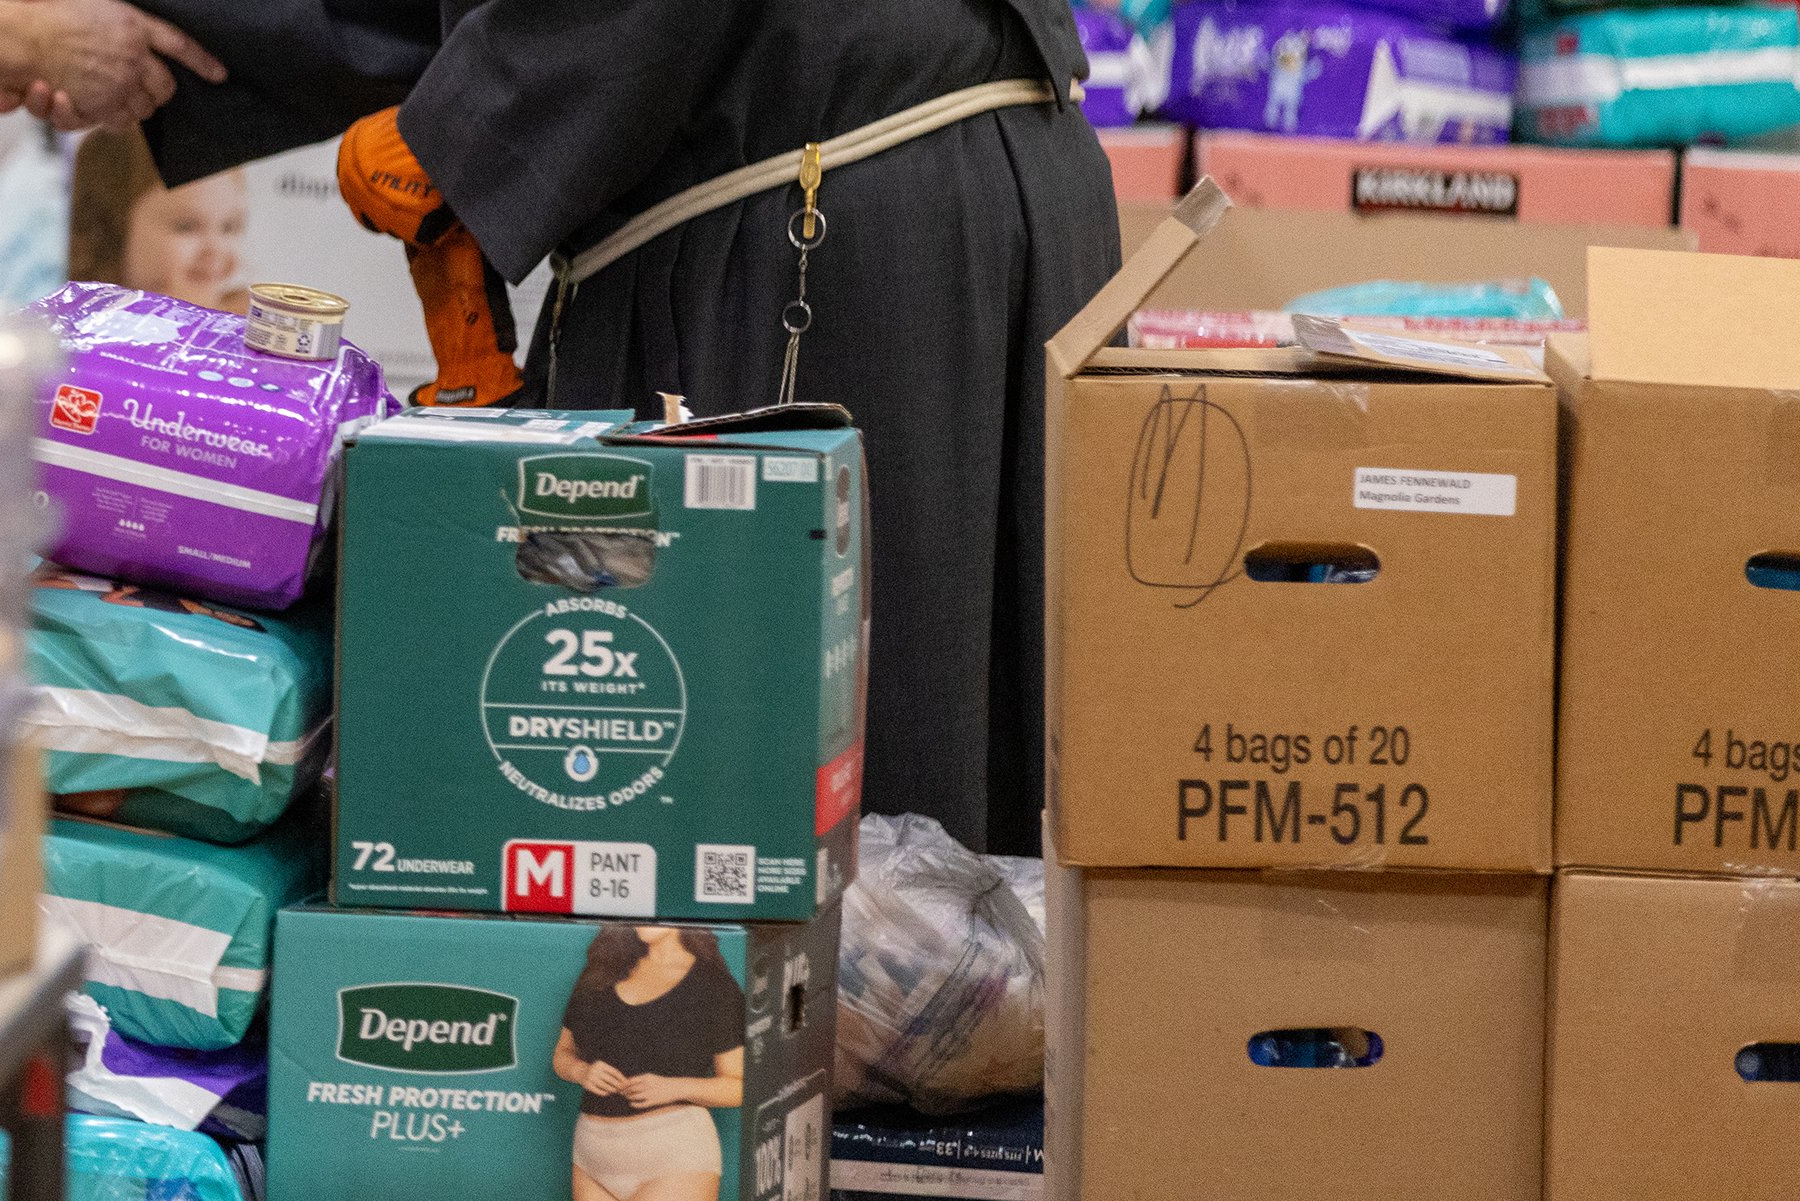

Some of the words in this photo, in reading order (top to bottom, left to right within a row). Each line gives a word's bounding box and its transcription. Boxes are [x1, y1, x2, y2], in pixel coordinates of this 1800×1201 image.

[371, 170, 433, 197] UTILITY
[1357, 169, 1516, 209] KIRKLAND
[123, 399, 270, 457] Underwear
[140, 436, 170, 453] FOR
[175, 441, 237, 469] WOMEN
[1360, 474, 1397, 485] JAMES
[1400, 476, 1471, 489] FENNEWALD
[1359, 490, 1411, 503] Magnolia
[1414, 493, 1461, 505] Gardens
[177, 545, 251, 569] SMALL/MEDIUM
[546, 597, 628, 619] ABSORBS
[543, 629, 638, 677] 25x
[541, 681, 568, 693] ITS
[1193, 723, 1214, 762] 4
[1227, 723, 1312, 774] bags
[1323, 725, 1359, 765] of
[1368, 726, 1410, 766] 20
[1692, 728, 1713, 766] 4
[499, 760, 606, 811] NEUTRALIZES
[609, 766, 664, 806] ODORS
[1177, 779, 1429, 845] PFM-512
[352, 841, 396, 872] 72
[398, 859, 475, 875] UNDERWEAR
[591, 852, 641, 873] PANT
[516, 849, 565, 897] M
[757, 876, 801, 885] AVAILABLE
[590, 879, 630, 898] 8-16
[757, 885, 789, 893] ONLINE
[307, 1082, 383, 1106] FRESH
[370, 1110, 466, 1142] PLUS+
